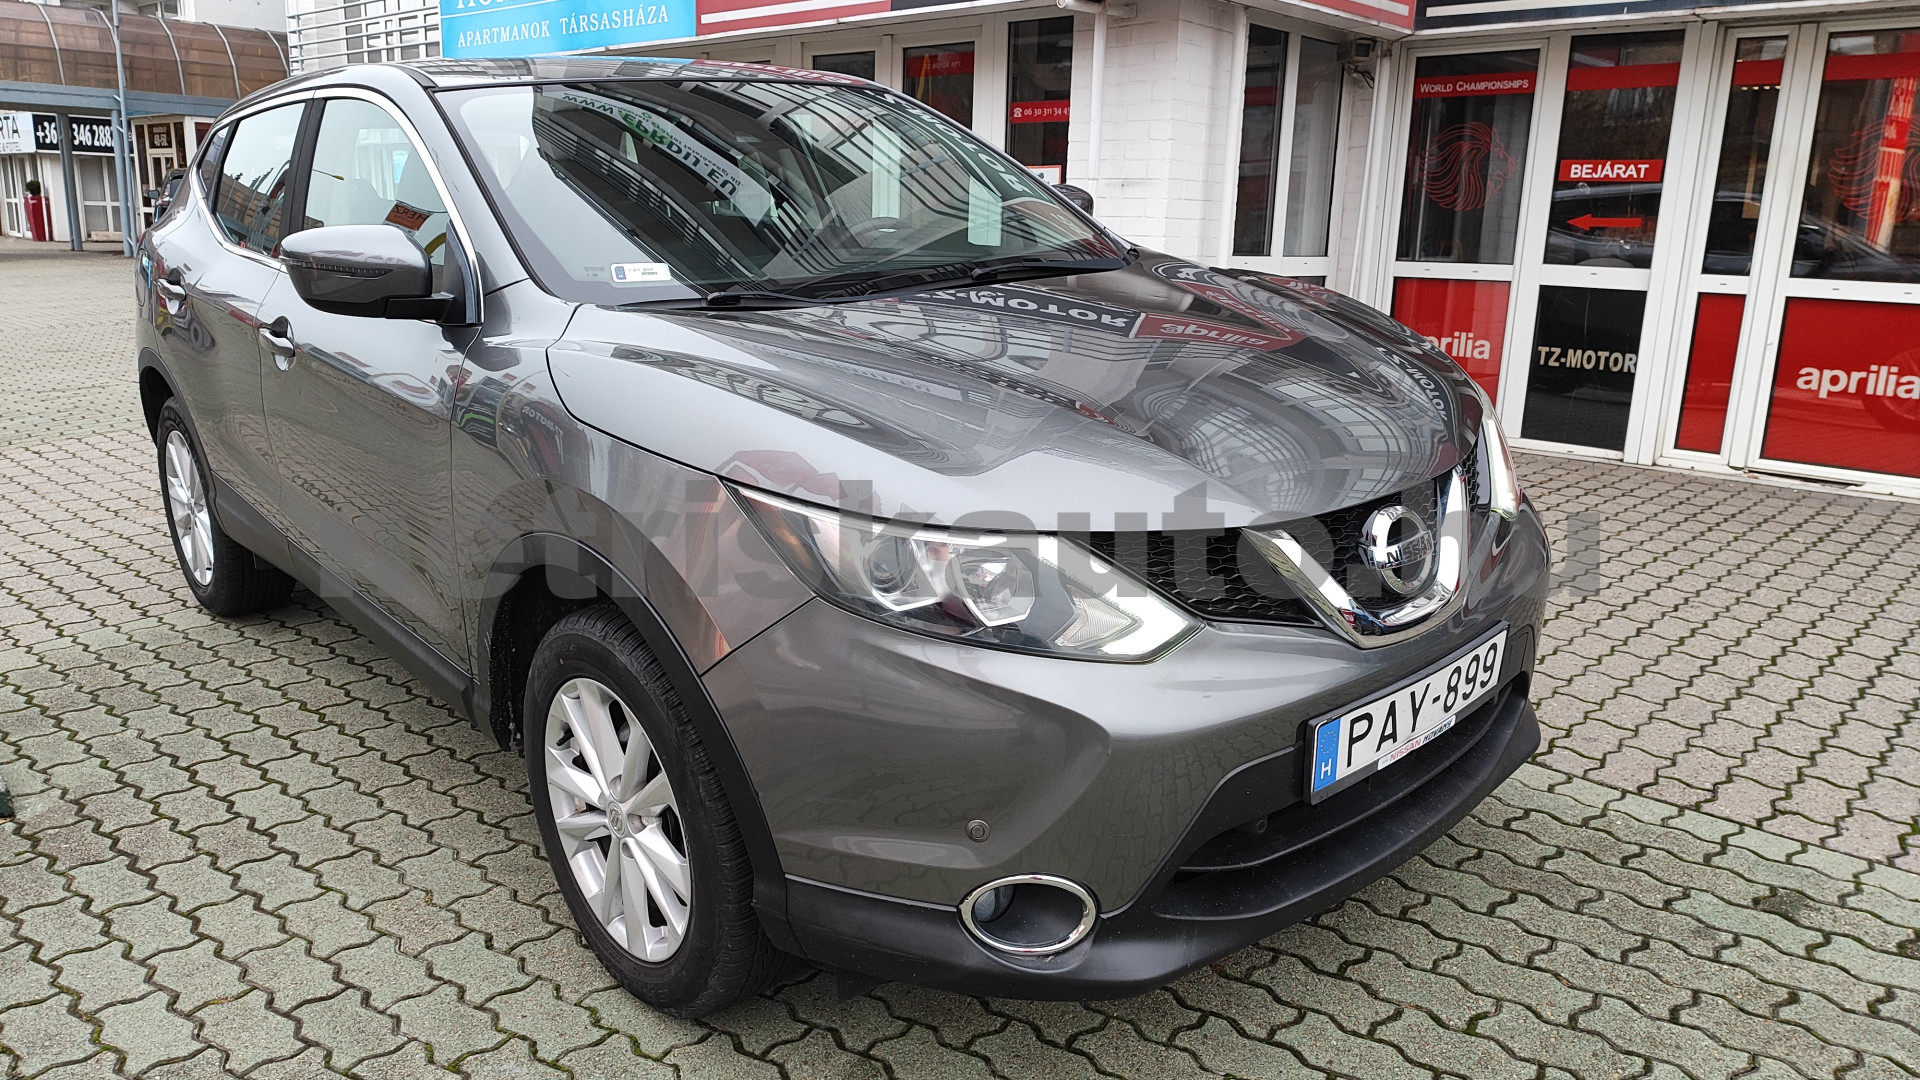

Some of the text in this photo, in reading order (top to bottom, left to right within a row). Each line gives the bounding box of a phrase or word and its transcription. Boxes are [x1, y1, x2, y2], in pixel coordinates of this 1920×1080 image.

[457, 4, 669, 48] APARTMANOK TÁRSASHÁZA
[1023, 107, 1033, 116] 06
[1033, 107, 1042, 117] 30
[1043, 106, 1053, 117] 311
[1053, 106, 1062, 117] 34
[72, 122, 92, 146] 346
[1570, 161, 1650, 179] BEJÁRAT
[1537, 346, 1638, 374] TZ-MOTOR
[1796, 364, 1920, 400] aprilia
[1387, 530, 1433, 564] NISSAN
[1320, 642, 1498, 780] H PAY-899
[1389, 738, 1422, 762] NISSAN
